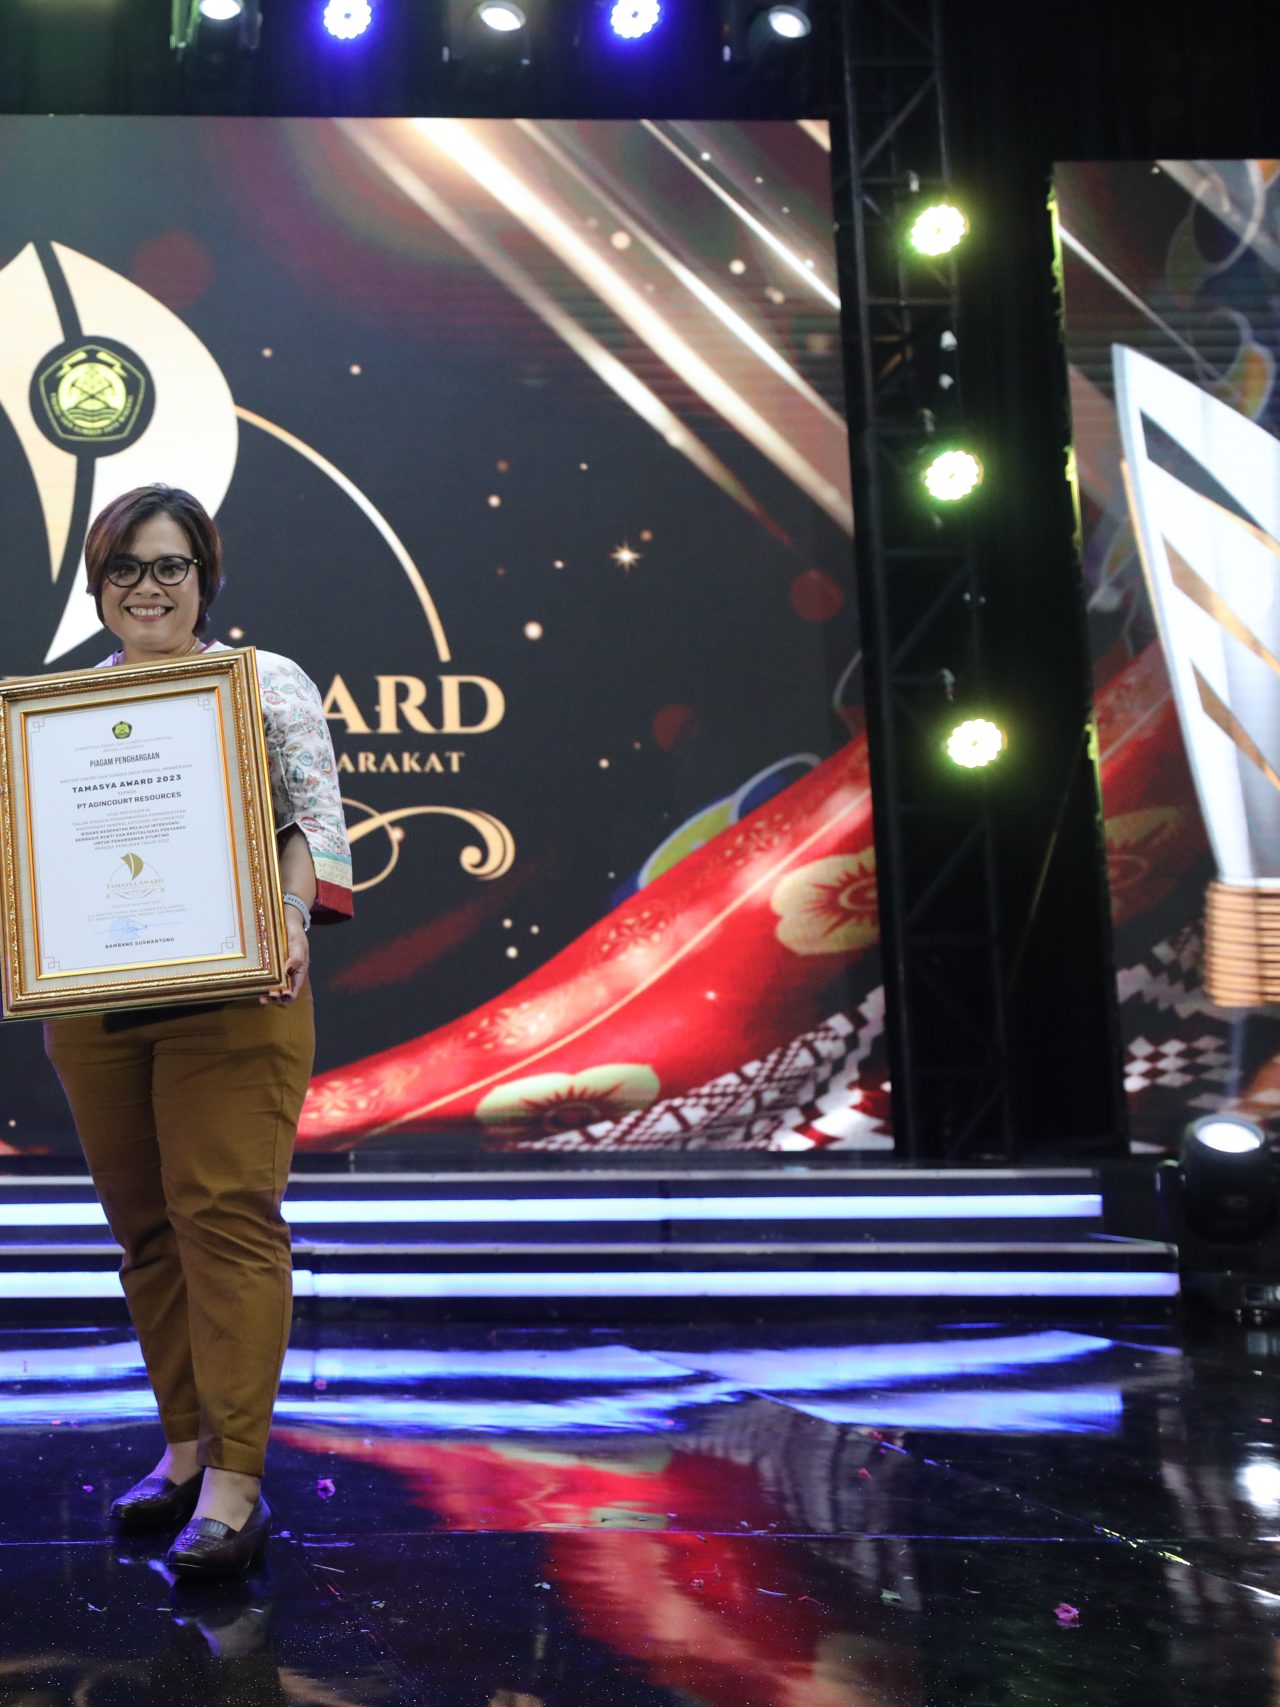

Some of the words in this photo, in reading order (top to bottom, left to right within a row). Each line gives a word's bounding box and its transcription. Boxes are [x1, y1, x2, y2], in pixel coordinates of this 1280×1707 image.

[322, 673, 506, 734] ARD
[90, 758, 113, 767] PIAGAM
[114, 752, 160, 764] PENGHARGAAN
[338, 751, 465, 774] ARAKAT
[72, 782, 117, 793] TAMASYA
[120, 778, 153, 787] AWARD
[156, 774, 181, 783] 2023
[88, 798, 133, 808] AGINCOURT
[135, 791, 182, 803] RESOURCES
